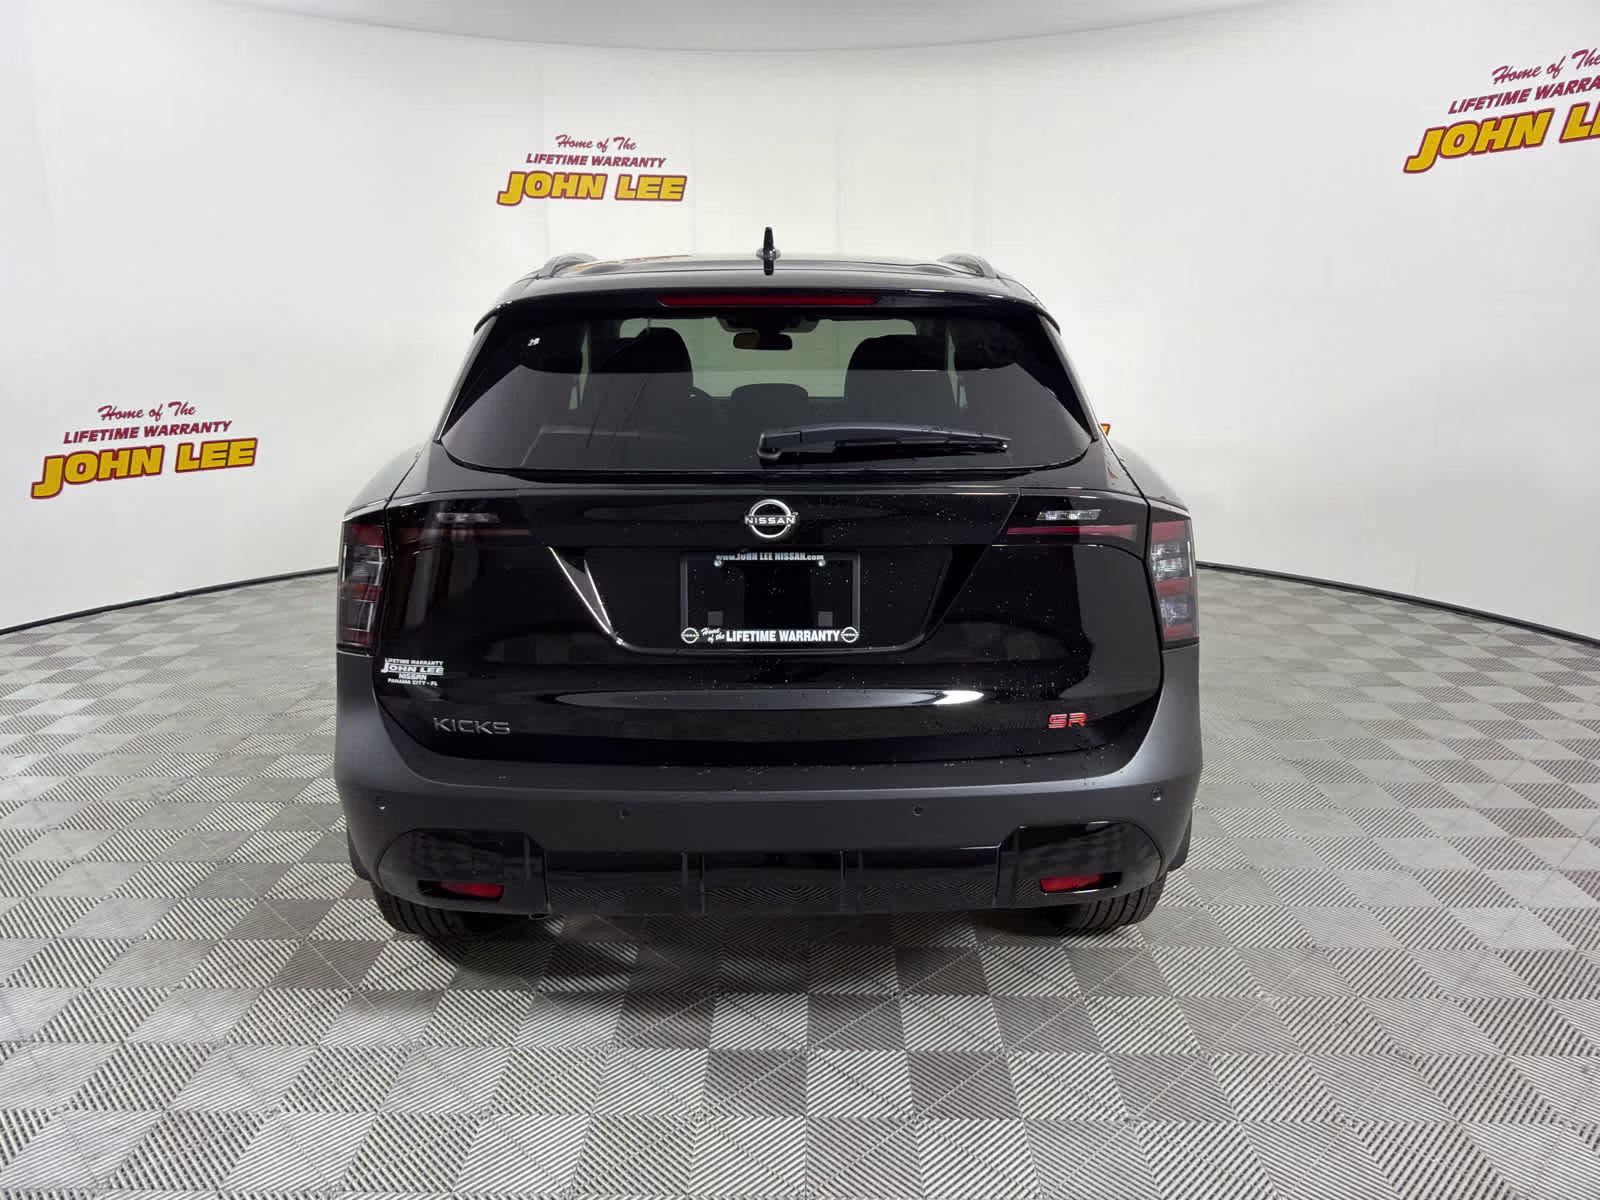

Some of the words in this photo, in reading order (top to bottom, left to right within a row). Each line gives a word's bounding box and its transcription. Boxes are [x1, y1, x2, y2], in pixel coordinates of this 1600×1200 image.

[1491, 65, 1542, 85] Home
[1546, 56, 1566, 79] of
[1571, 47, 1600, 70] The
[1448, 87, 1533, 114] LIFETIME
[555, 134, 593, 149] Home
[596, 137, 609, 153] of
[613, 136, 637, 151] The
[1403, 107, 1555, 174] JOHN
[526, 153, 589, 166] LIFETIME
[591, 155, 667, 168] WARRANTY
[496, 171, 608, 207] JOHN
[614, 174, 688, 202] LEE
[97, 405, 144, 421] Home
[148, 404, 163, 422] of
[168, 401, 196, 417] The
[63, 426, 140, 444] LIFETIME
[143, 420, 232, 438] WARRANTY
[30, 444, 165, 499] JOHN
[175, 437, 258, 473] LEE
[744, 516, 796, 525] NISSAN
[759, 552, 774, 561] LEE
[726, 629, 777, 642] LIFETIME
[778, 629, 841, 642] WARRANTY
[380, 663, 417, 674] JOHN
[419, 665, 444, 674] LEE
[433, 717, 510, 735] KICKS
[1048, 712, 1087, 729] SR
